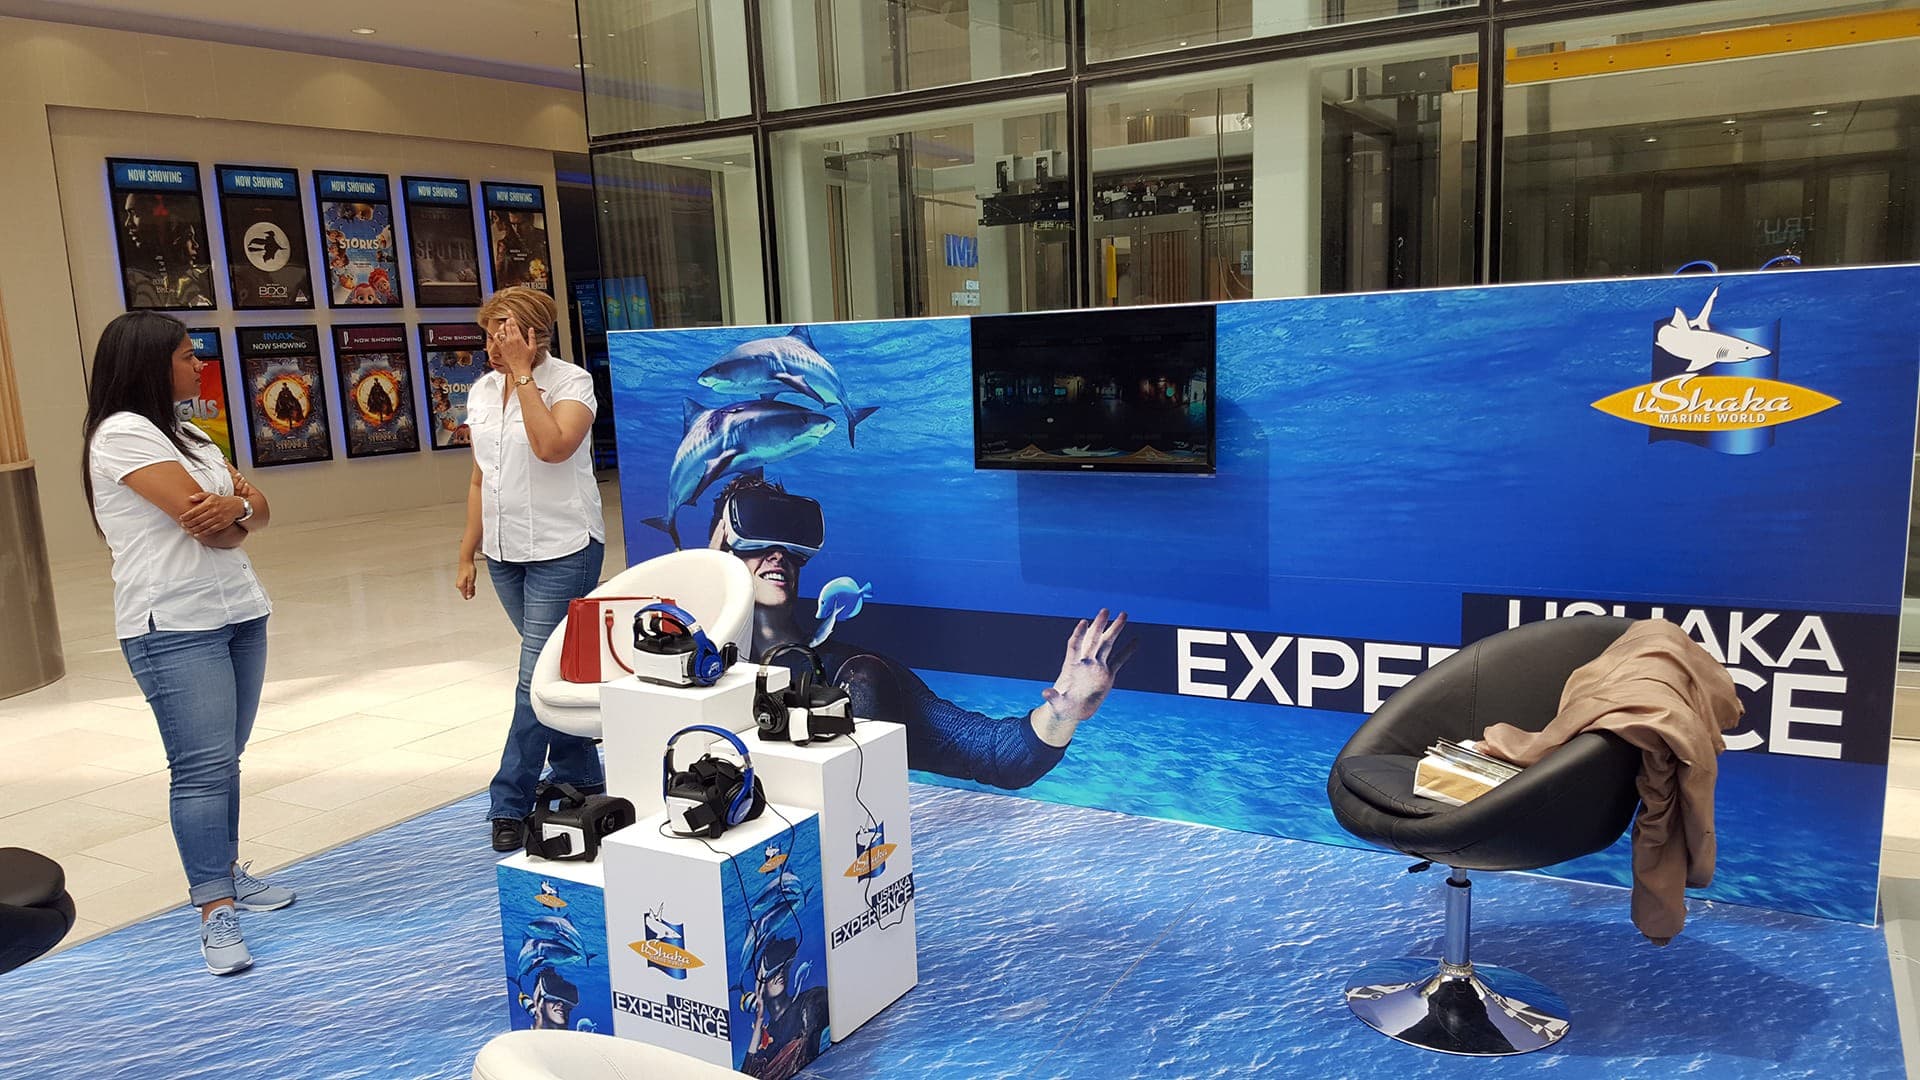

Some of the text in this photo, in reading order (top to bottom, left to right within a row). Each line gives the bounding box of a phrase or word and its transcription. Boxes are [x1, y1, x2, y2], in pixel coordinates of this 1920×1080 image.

[128, 169, 182, 184] NOW SHOWING
[235, 175, 284, 189] NOW SHOWING
[331, 180, 376, 194] NOW SHOWING
[418, 185, 458, 199] NOW SHOWING
[497, 191, 533, 203] NOW SHOWING
[340, 237, 379, 249] STORKS
[263, 332, 294, 340] IMAX
[272, 342, 307, 350] SHOWING
[442, 383, 474, 394] STORK
[1632, 373, 1793, 414] uShaka
[1659, 413, 1766, 424] MARINE WORLD
[1507, 598, 1845, 672] AKA
[876, 875, 912, 903] USHAKA
[833, 886, 912, 948] EXPERIENCE
[641, 939, 690, 964] uShaka
[615, 992, 729, 1040] EXPERIENCE
[673, 997, 727, 1022] USHAKA
